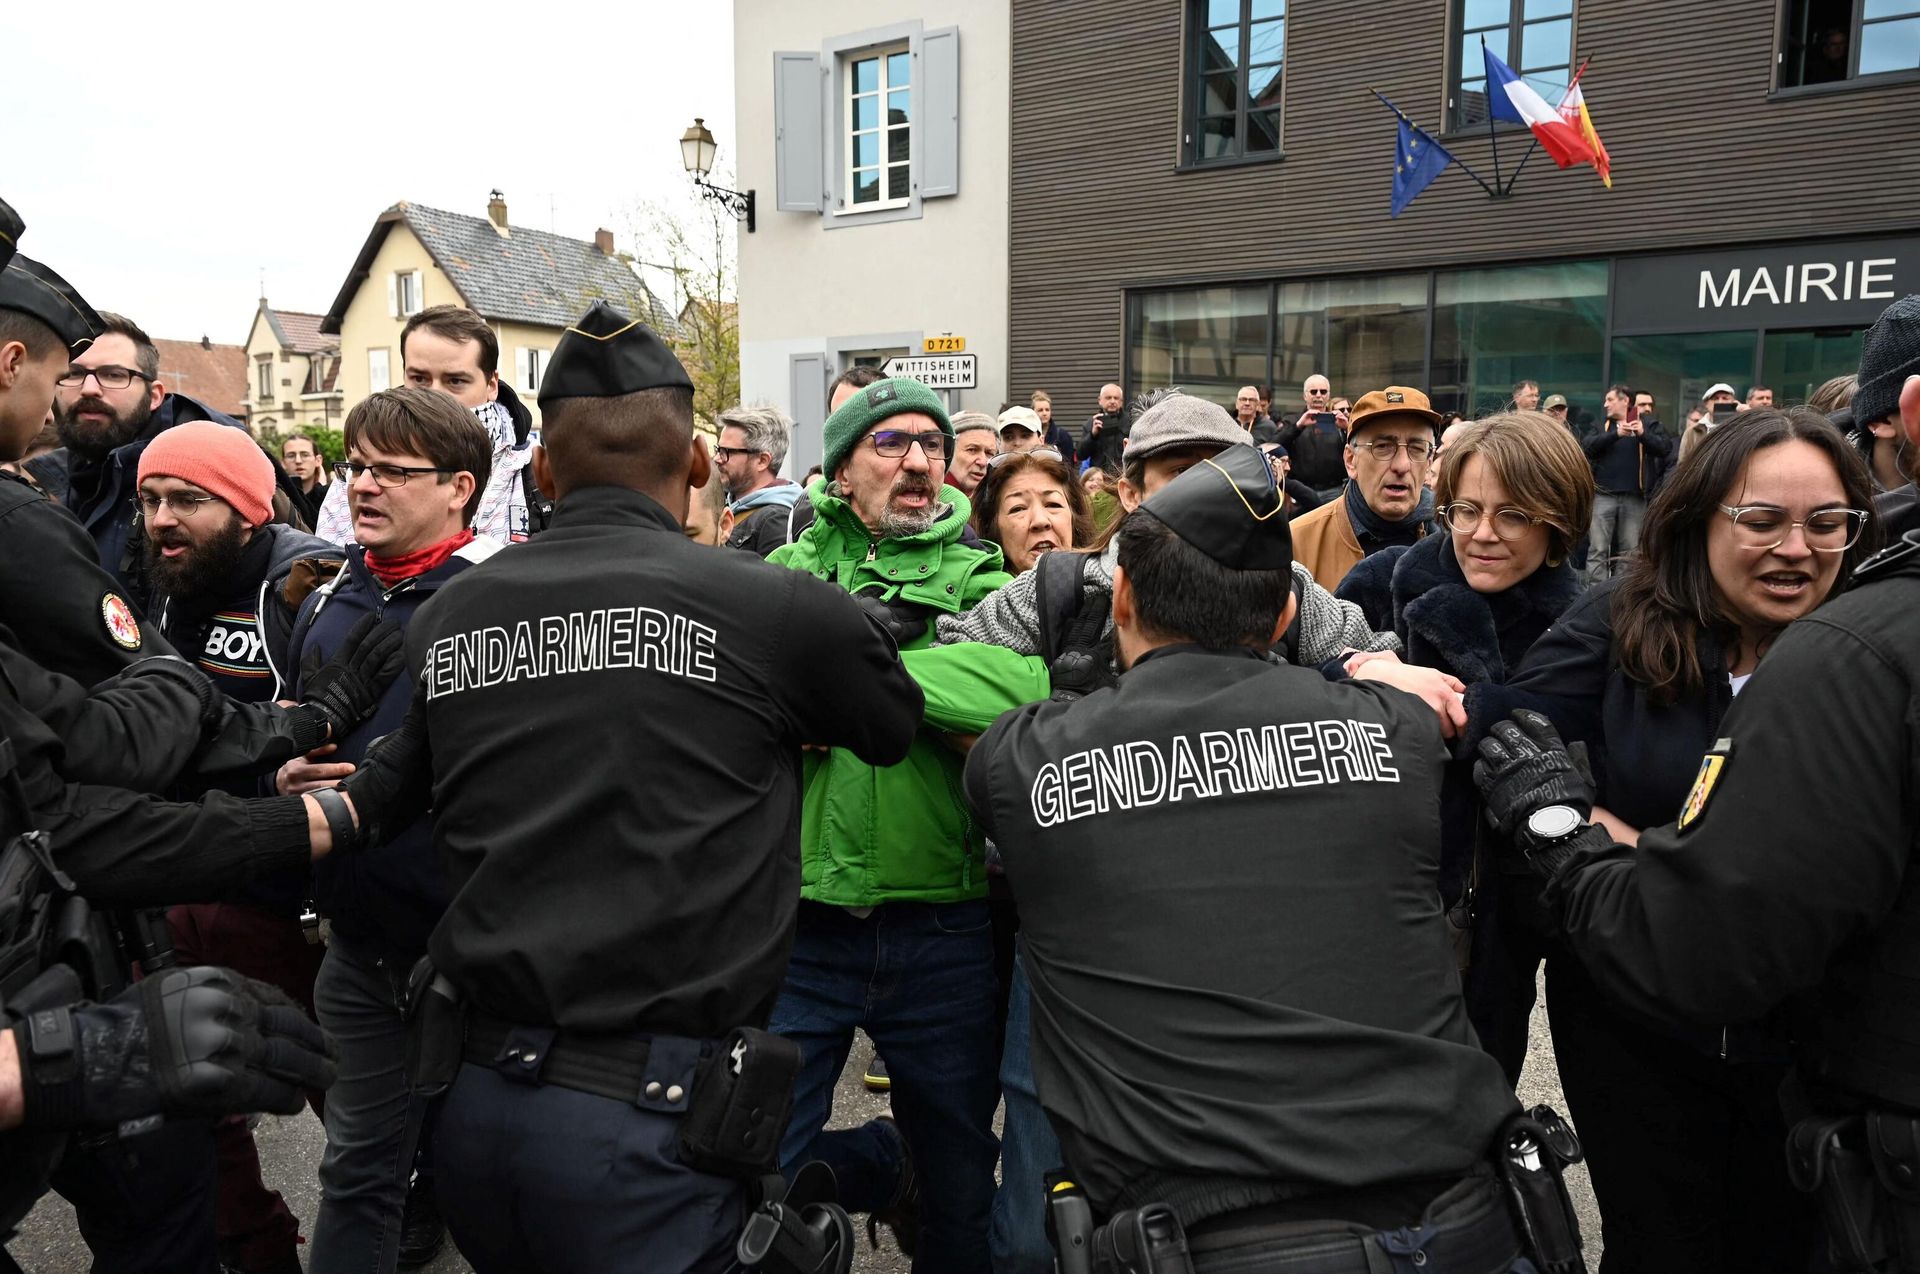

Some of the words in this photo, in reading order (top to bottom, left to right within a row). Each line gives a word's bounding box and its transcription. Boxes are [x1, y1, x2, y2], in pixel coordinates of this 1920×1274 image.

[1698, 257, 1897, 308] MAIRIE
[928, 340, 935, 350] D
[939, 338, 960, 350] 721
[895, 360, 971, 372] WITTISHEIM
[894, 373, 971, 384] SENHEIM
[204, 625, 262, 662] BOY
[1031, 719, 1400, 827] GENDARMERIE
